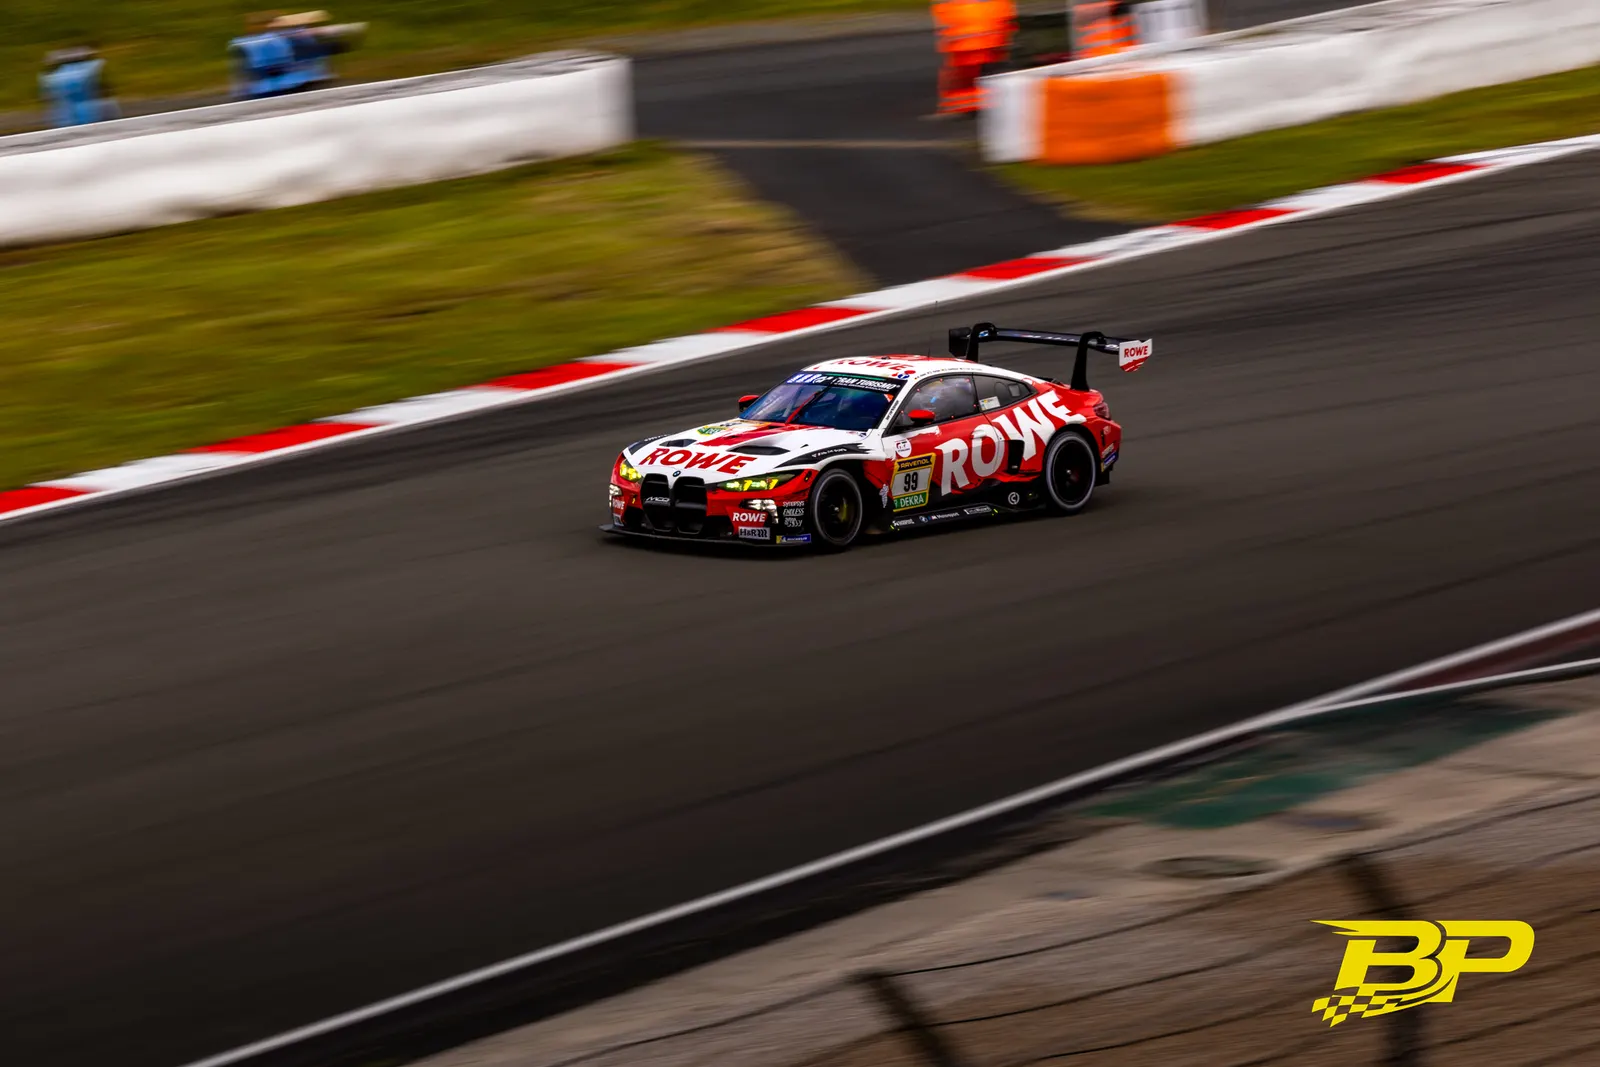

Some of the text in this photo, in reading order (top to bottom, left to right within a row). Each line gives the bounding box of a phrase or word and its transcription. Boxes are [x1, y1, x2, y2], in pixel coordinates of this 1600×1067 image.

[1124, 345, 1148, 358] ROWE
[858, 379, 896, 391] TURISMO
[935, 390, 1087, 496] ROWE
[639, 447, 758, 475] ROWE
[900, 458, 929, 469] RAVENOL
[904, 472, 918, 492] 99
[900, 494, 924, 508] DEKRA
[733, 512, 766, 522] ROWE
[740, 528, 757, 538] H&R
